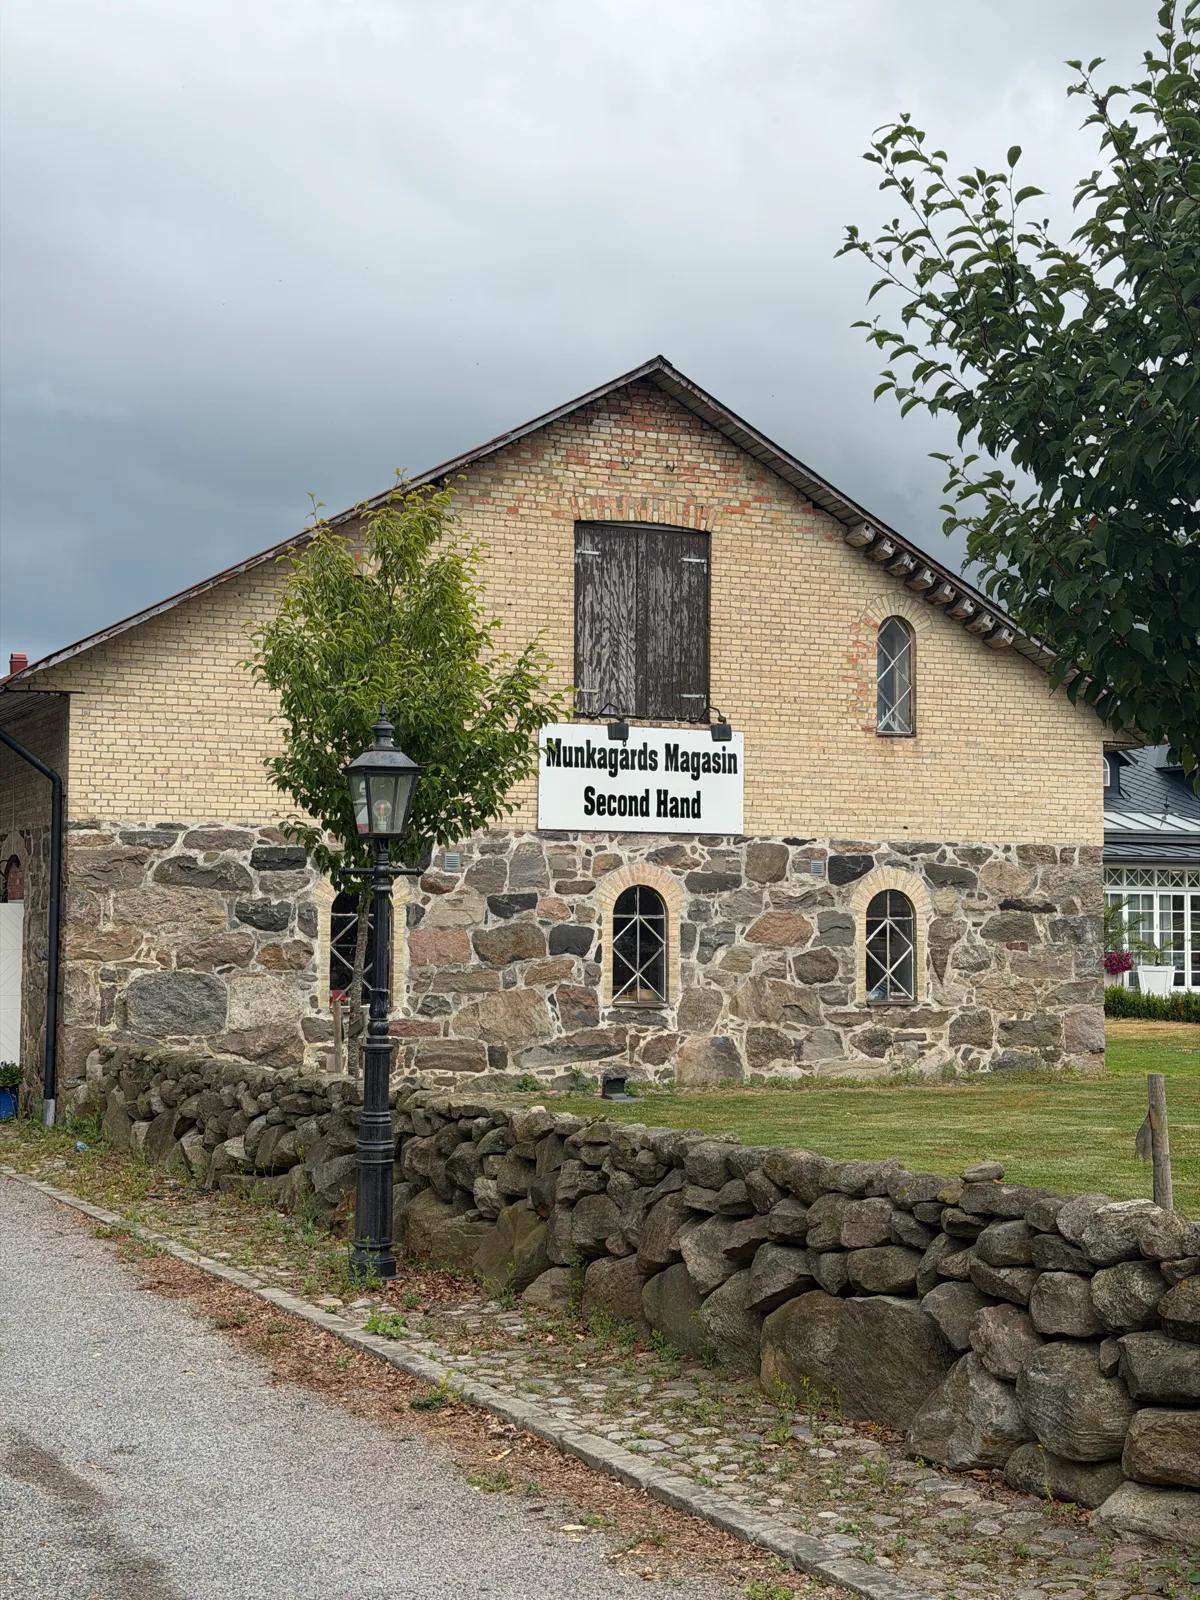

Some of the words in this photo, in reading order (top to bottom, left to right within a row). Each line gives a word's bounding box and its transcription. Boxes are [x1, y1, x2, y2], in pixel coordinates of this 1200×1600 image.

[546, 738, 658, 778] Munkagårds
[665, 743, 738, 781] Magasin
[584, 786, 650, 818] Second
[656, 788, 701, 819] Hand
